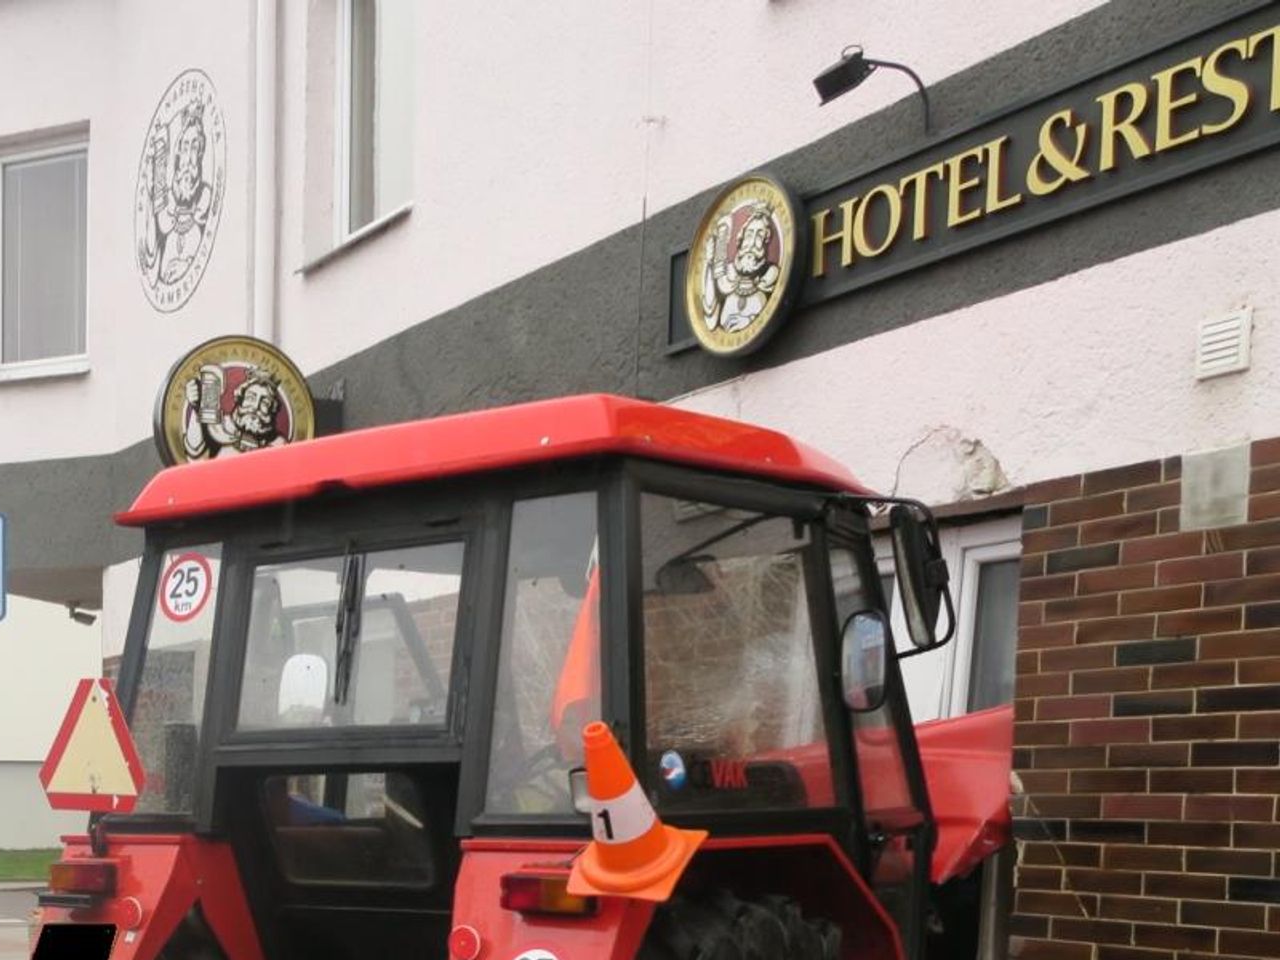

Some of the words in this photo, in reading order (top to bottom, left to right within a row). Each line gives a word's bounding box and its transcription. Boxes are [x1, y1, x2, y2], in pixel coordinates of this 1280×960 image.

[811, 135, 1021, 277] HOTEL
[169, 566, 200, 599] 25
[174, 600, 192, 613] km
[597, 808, 614, 840] 1
